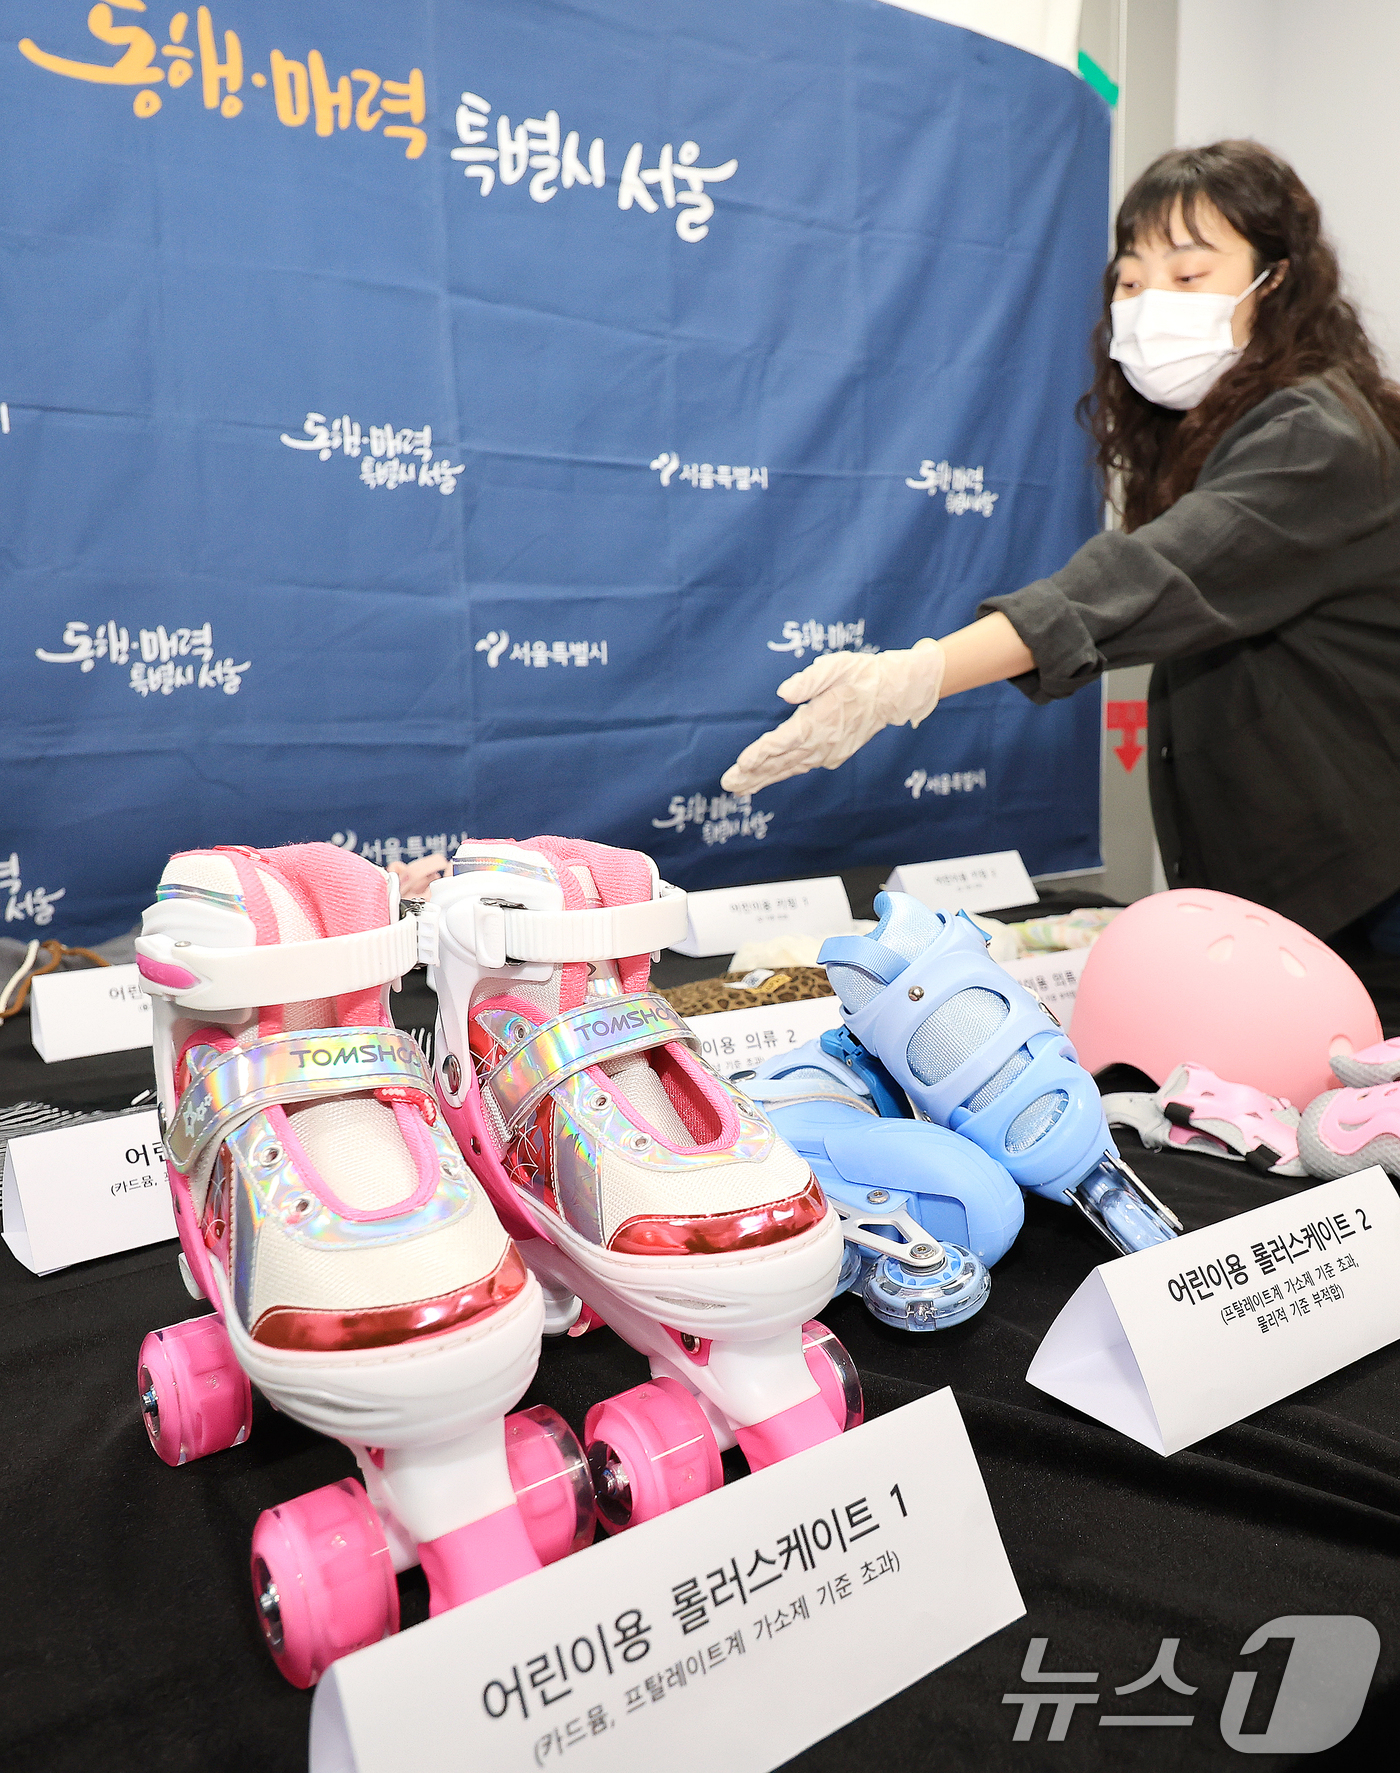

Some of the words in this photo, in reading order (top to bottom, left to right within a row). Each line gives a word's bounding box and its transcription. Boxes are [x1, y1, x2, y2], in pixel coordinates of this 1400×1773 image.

[450, 92, 607, 204] 특별시
[617, 141, 738, 242] 서울
[679, 463, 769, 491] 서울특별시
[35, 619, 214, 673] 동행·매력
[509, 639, 608, 668] 서울특별시
[197, 657, 251, 696] 서울
[786, 1029, 797, 1043] 2
[1167, 1253, 1249, 1305] 어린이용
[1250, 1212, 1356, 1276] 롤러스케이트
[1355, 1208, 1373, 1231] 2
[1220, 1284, 1285, 1326] (프탈레이트계
[1284, 1271, 1316, 1294] 가소제
[1315, 1262, 1336, 1281] 기준
[1336, 1253, 1360, 1272] 초과,
[1257, 1307, 1290, 1334] 물리적
[1289, 1297, 1311, 1317] 기준
[1311, 1283, 1345, 1308] 부적합)
[481, 1606, 653, 1721] 어린이용
[670, 1496, 881, 1636] 롤러스케이트
[889, 1482, 909, 1518] 1
[624, 1629, 747, 1713] 프탈레이트계
[753, 1594, 811, 1640] 가소제
[816, 1572, 854, 1606] 기준
[860, 1549, 901, 1586] 초과)
